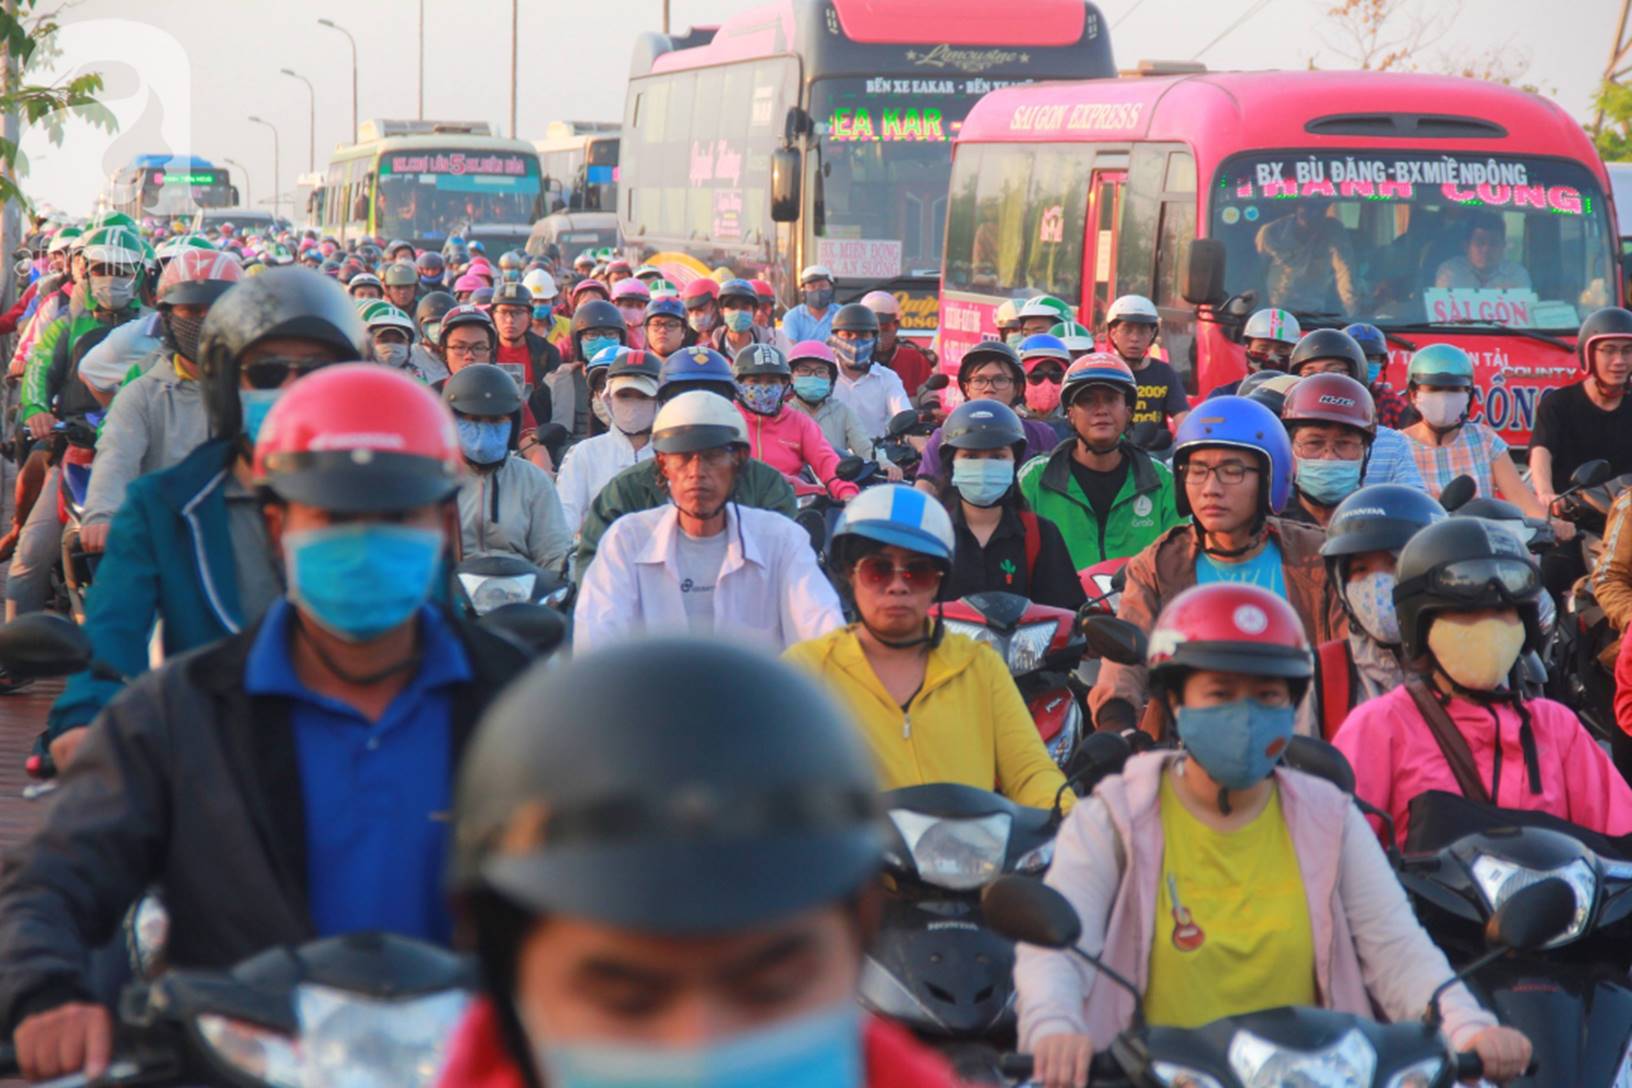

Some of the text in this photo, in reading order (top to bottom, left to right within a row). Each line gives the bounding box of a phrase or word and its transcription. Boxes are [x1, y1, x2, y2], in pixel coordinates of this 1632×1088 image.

[915, 43, 1018, 68] Limousine
[866, 77, 891, 93] BẾN
[893, 80, 910, 93] XE
[912, 80, 955, 94] EAKAR
[966, 78, 991, 94] BẾN
[835, 107, 873, 137] EA
[883, 107, 943, 137] KAR
[1009, 102, 1144, 130] SAIGON EXPRESS
[1255, 162, 1283, 186] BX
[1296, 155, 1325, 184] BÙ
[1434, 294, 1530, 326] SÀI GÒN
[1483, 347, 1509, 368] TẢI
[1501, 366, 1577, 376] COUNTY
[1467, 373, 1557, 431] CÔN
[1131, 517, 1154, 528] Grab
[1342, 507, 1386, 519] HONDA
[927, 922, 979, 931] HONDA
